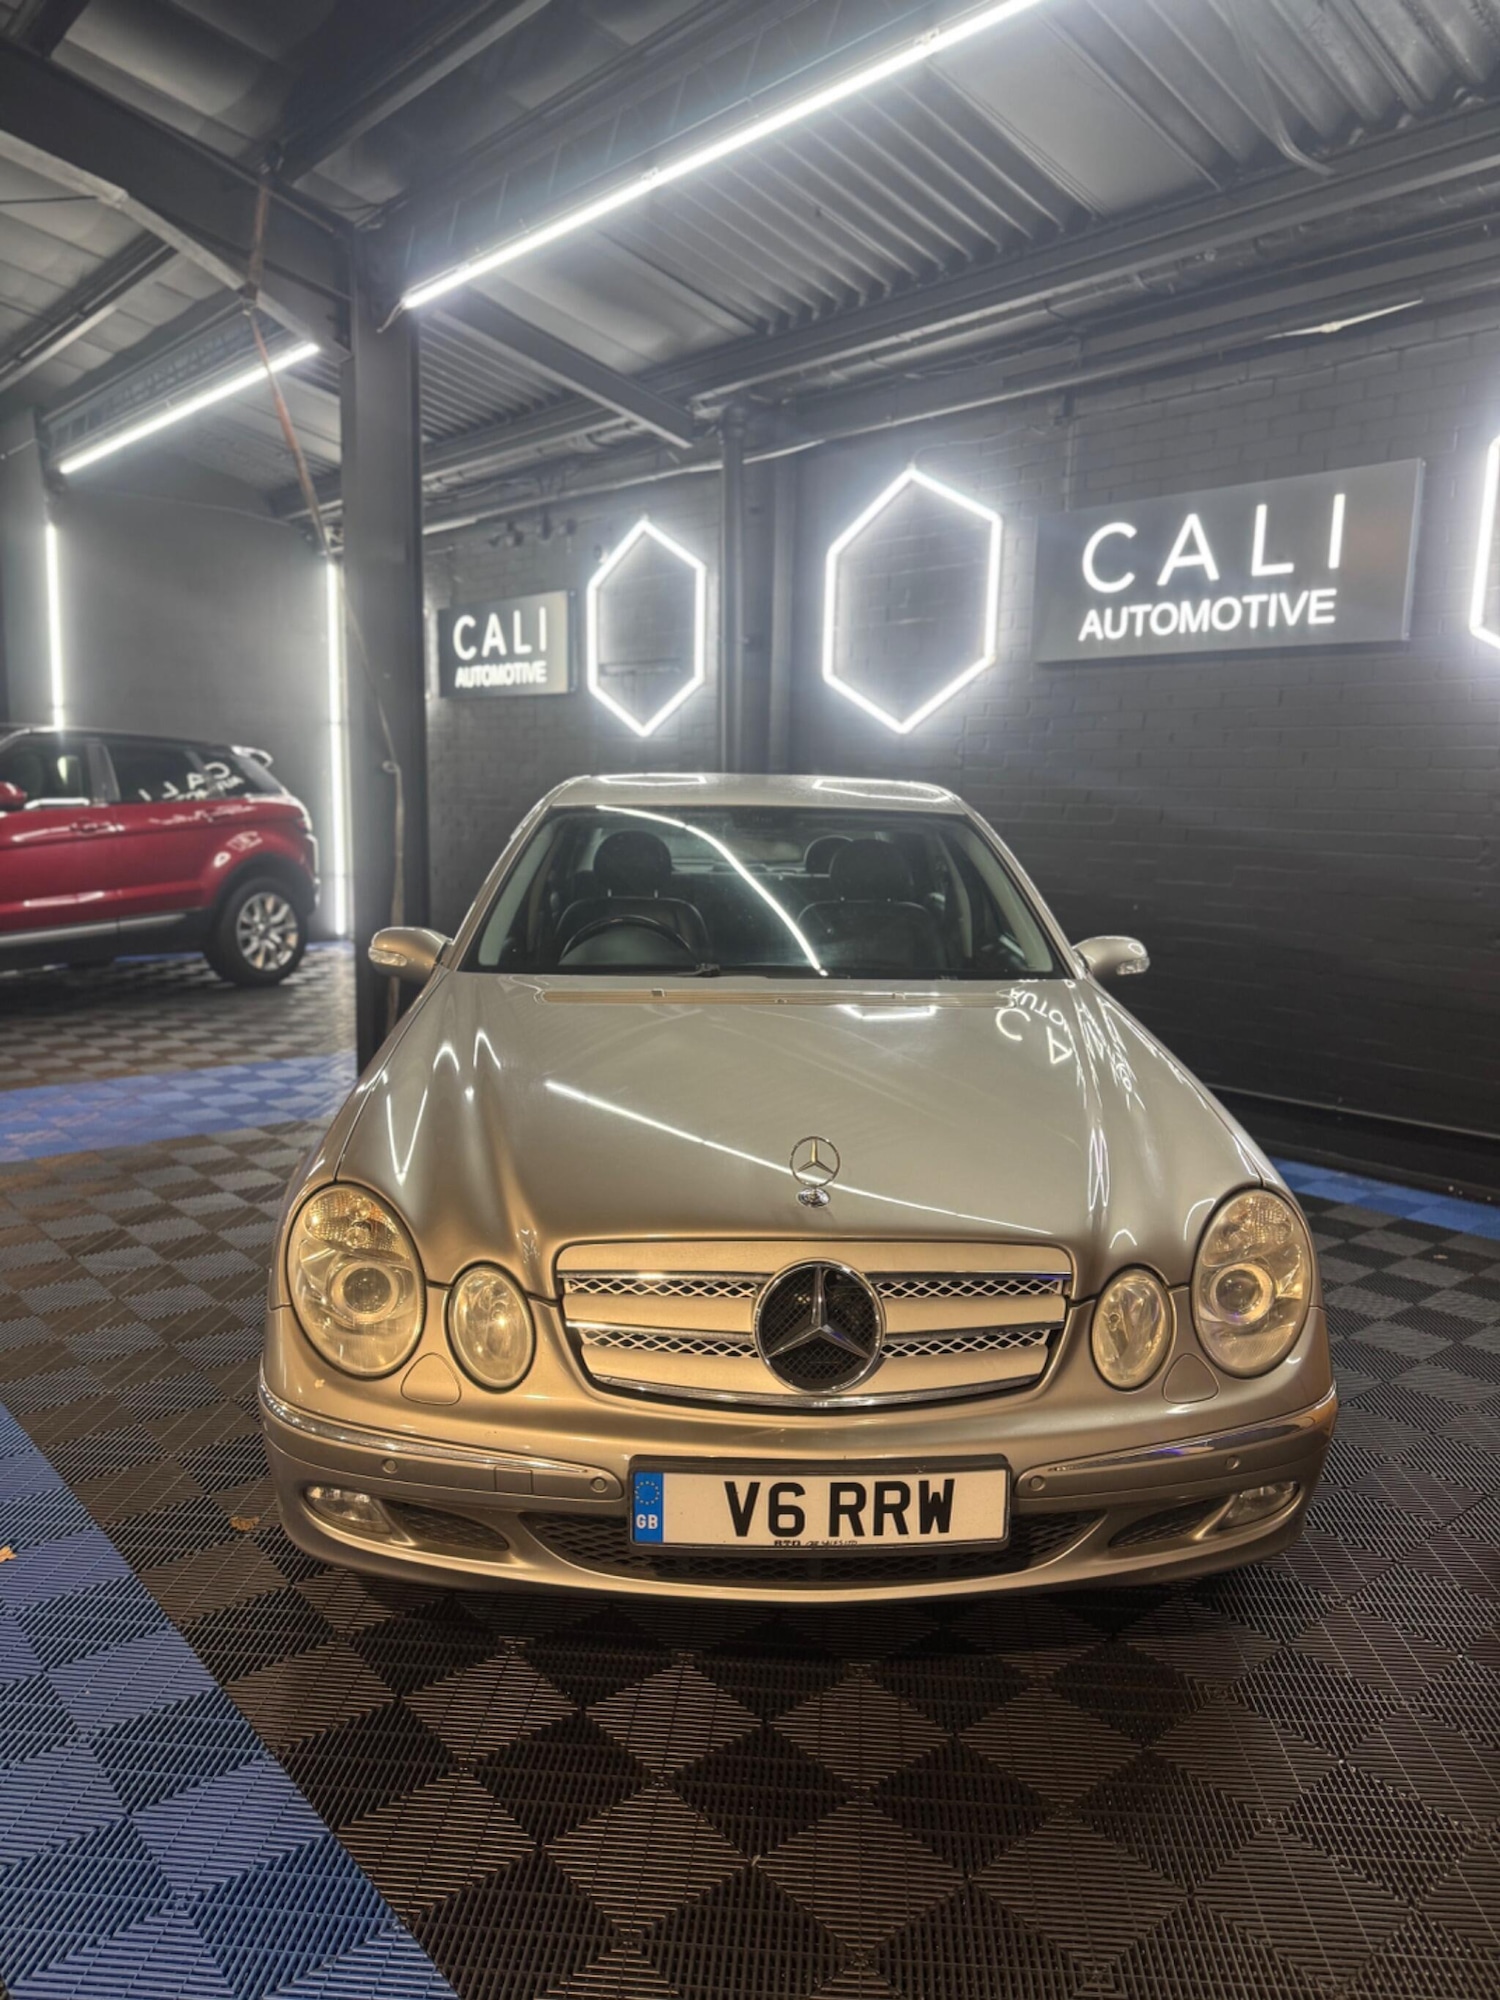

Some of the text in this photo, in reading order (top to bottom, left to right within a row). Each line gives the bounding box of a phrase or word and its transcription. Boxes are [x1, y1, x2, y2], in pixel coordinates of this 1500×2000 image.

[1082, 494, 1345, 593] CALI
[453, 607, 546, 660] CALI
[1078, 589, 1337, 641] AUTOMOTIVE
[455, 660, 547, 688] AUTOMOTIVE
[636, 1513, 658, 1529] GB
[724, 1479, 955, 1537] V6 RRW
